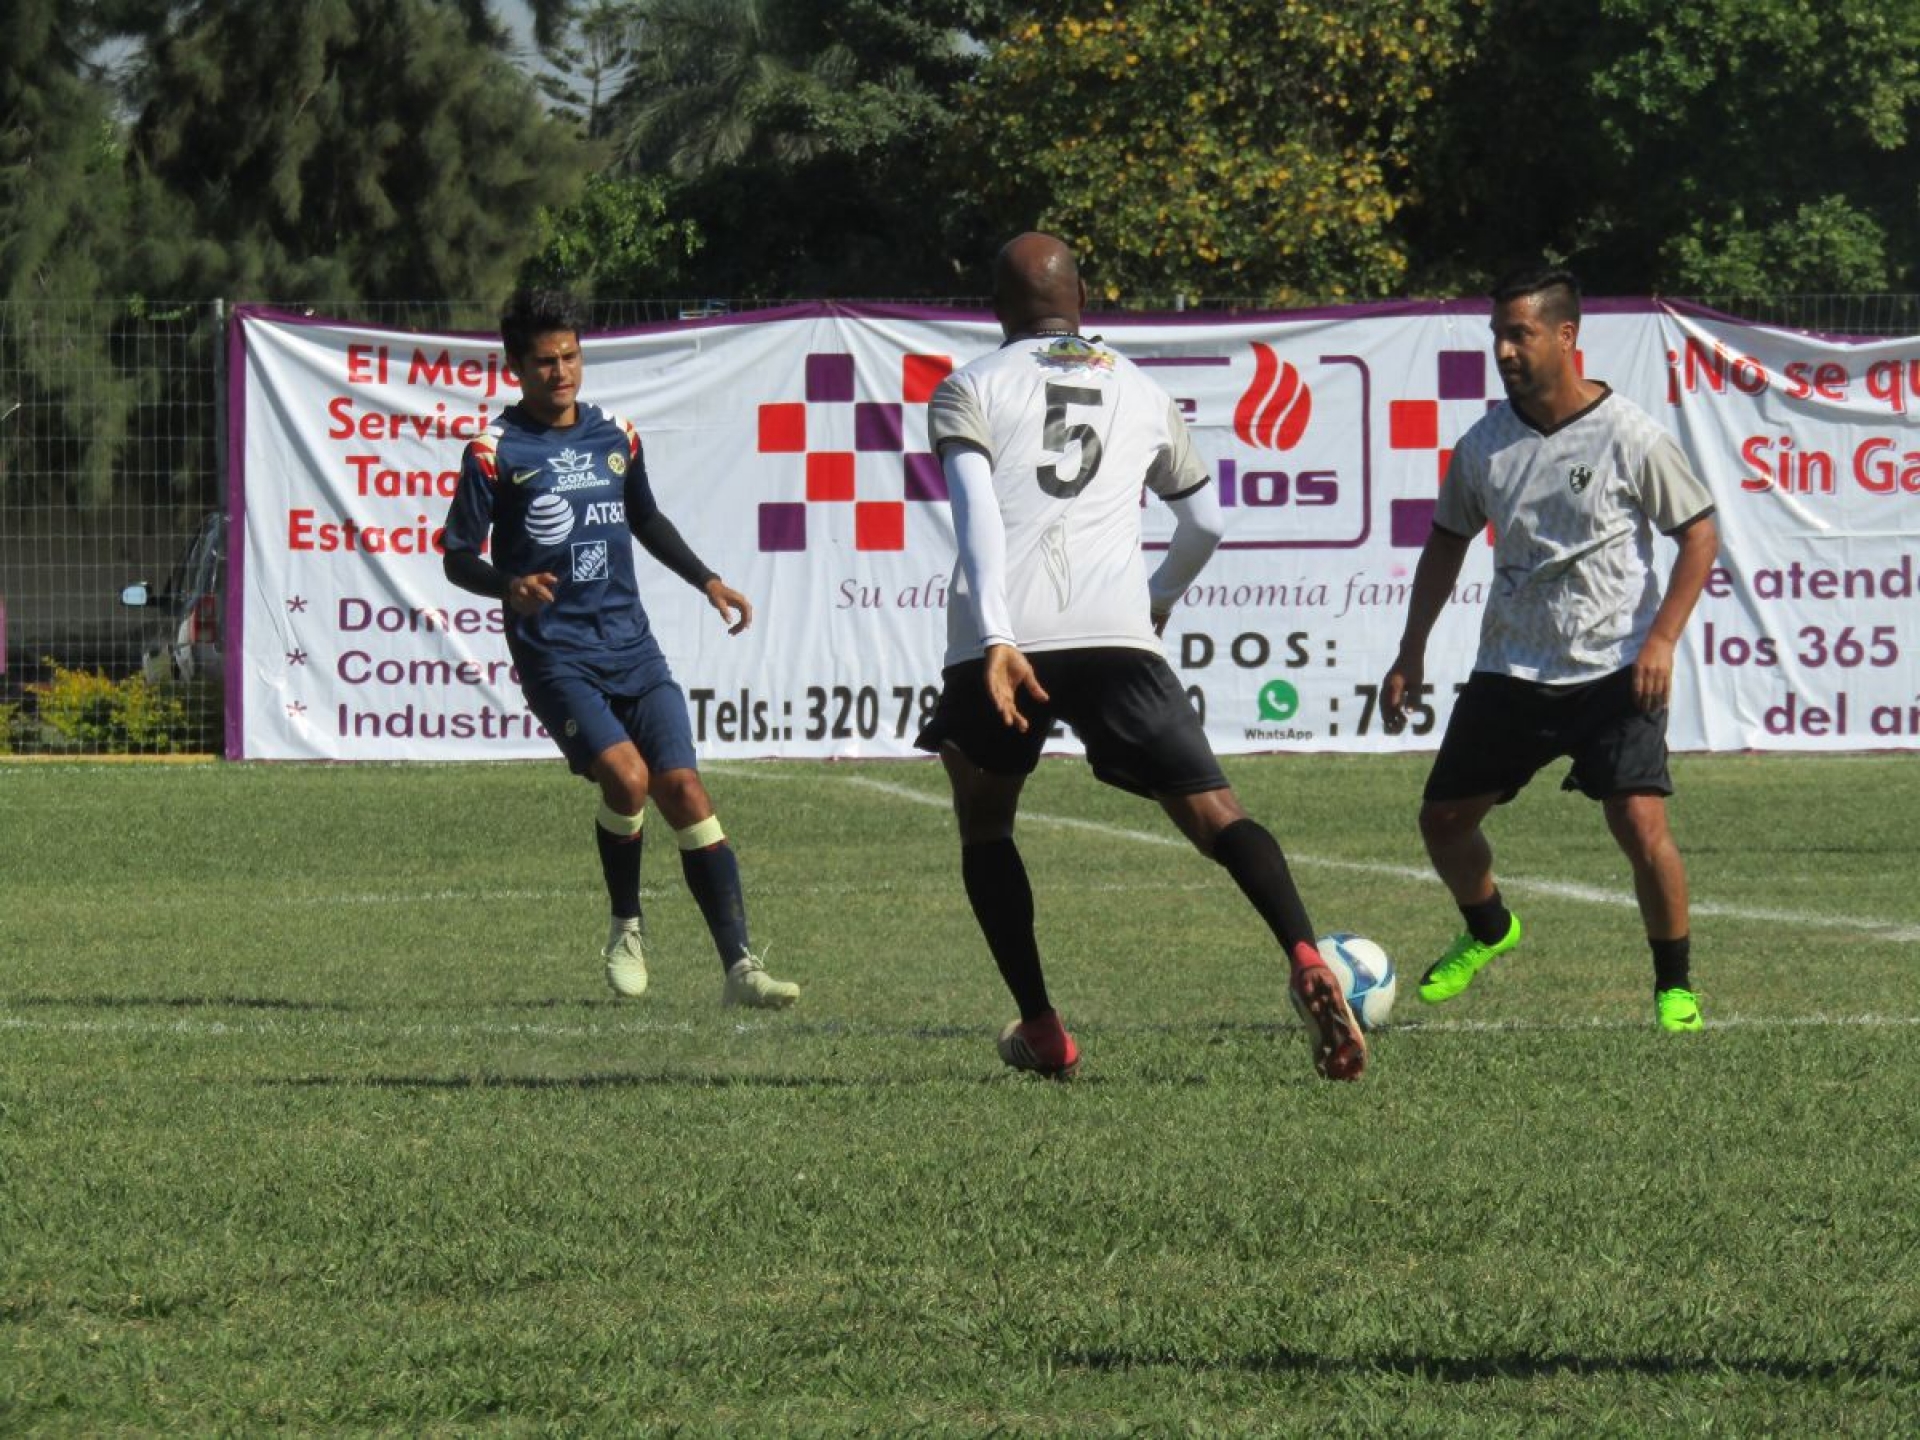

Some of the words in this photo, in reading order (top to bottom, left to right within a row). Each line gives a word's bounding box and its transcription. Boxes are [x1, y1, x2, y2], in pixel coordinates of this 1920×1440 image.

[347, 344, 389, 385] El
[1784, 360, 1849, 399] se
[328, 396, 488, 441] Servici
[1036, 382, 1103, 499] 5
[1741, 435, 1835, 493] Sin
[835, 578, 883, 609] Su
[1753, 555, 1920, 600] atend
[337, 597, 505, 634] Domes
[1703, 622, 1779, 667] los
[1797, 625, 1899, 669] 365
[806, 685, 879, 742] 320
[1244, 728, 1314, 741] WhatsApp
[1764, 691, 1846, 736] del
